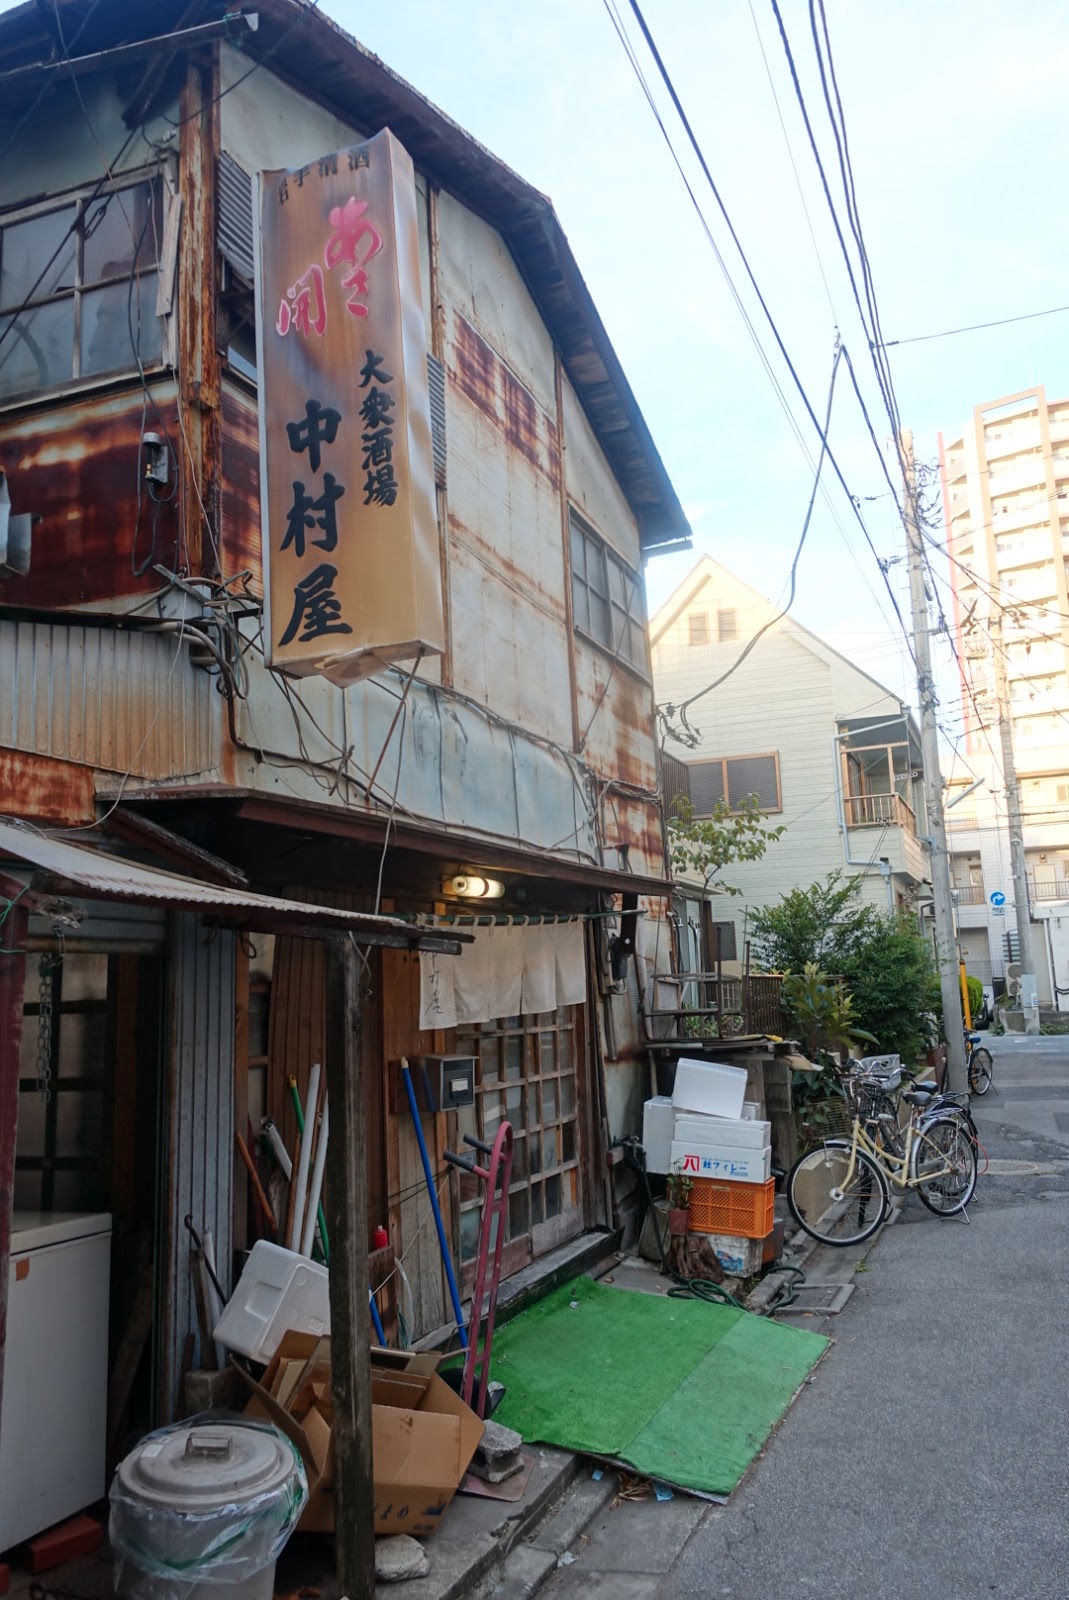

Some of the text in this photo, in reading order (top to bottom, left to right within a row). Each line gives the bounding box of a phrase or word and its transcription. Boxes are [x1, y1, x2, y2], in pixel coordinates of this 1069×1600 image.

[278, 399, 353, 647] 中村屋
[358, 350, 399, 507] 大衆酒場
